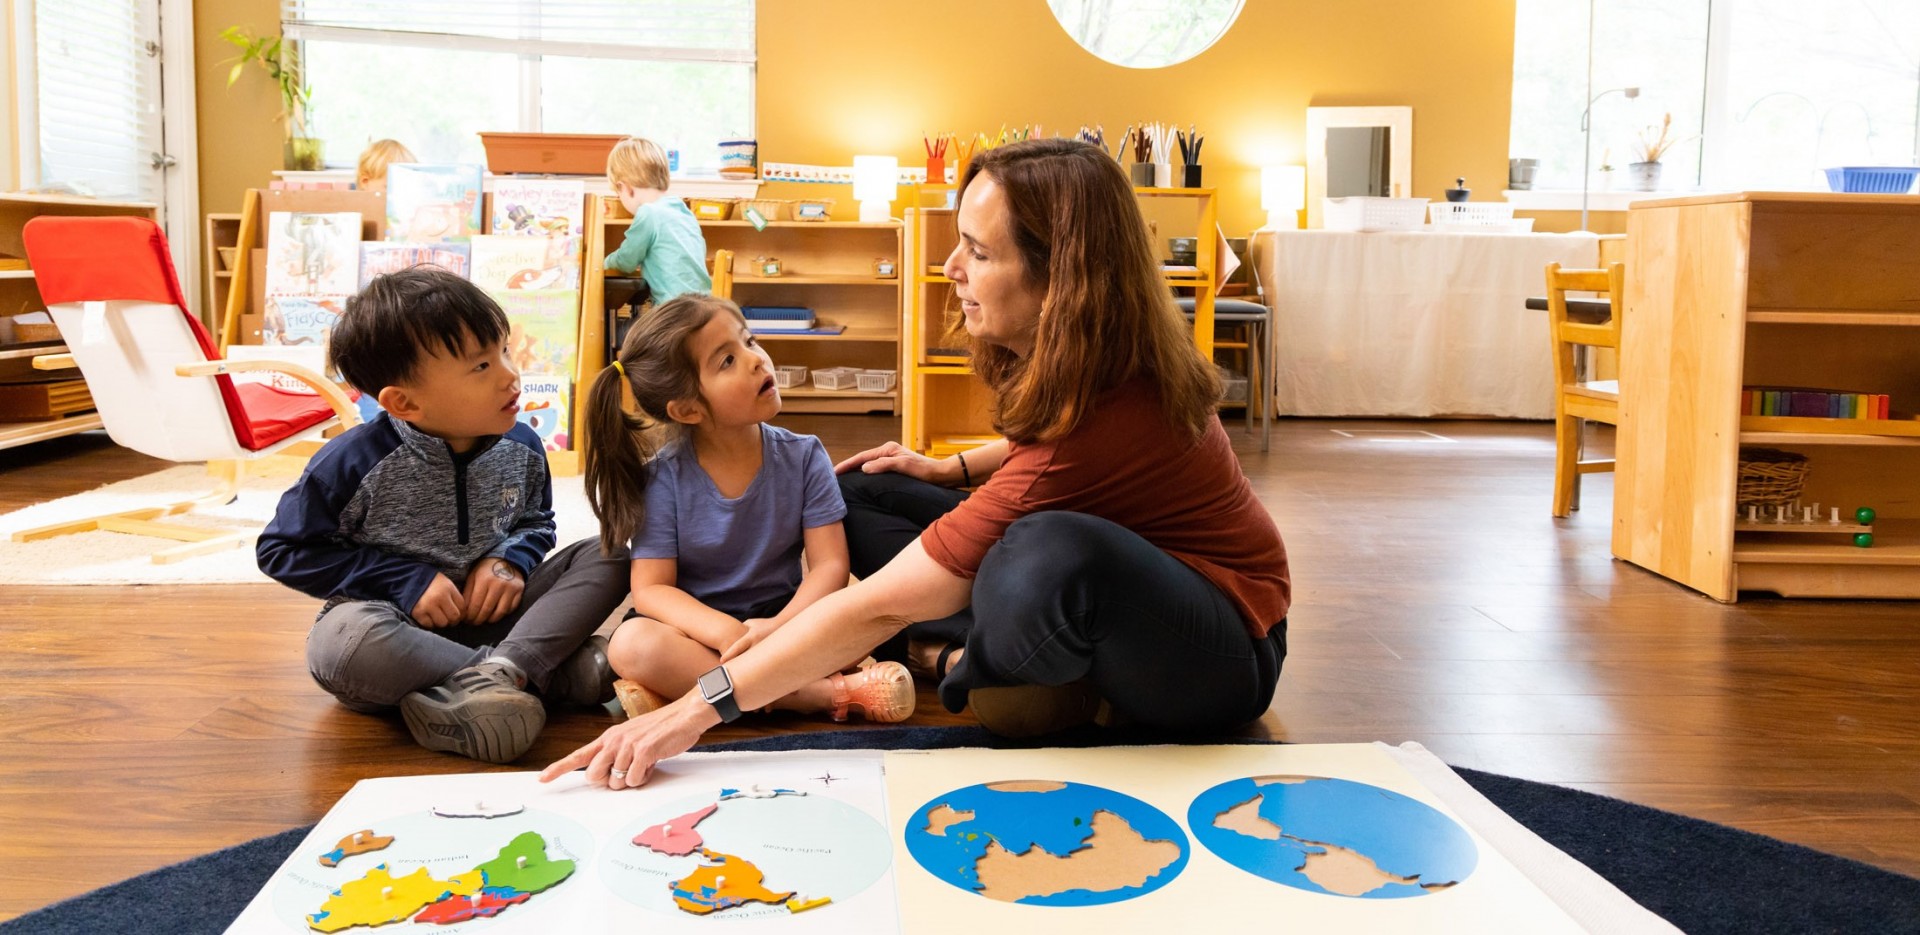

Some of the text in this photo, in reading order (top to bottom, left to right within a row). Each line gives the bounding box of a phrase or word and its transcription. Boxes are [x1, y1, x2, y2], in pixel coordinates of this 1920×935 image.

[498, 185, 543, 205] Marley
[285, 311, 336, 328] Fiasco
[271, 375, 307, 391] King
[524, 383, 558, 393] SHARK
[762, 843, 832, 854] Pacific Ocean
[398, 856, 431, 865] Ocean
[635, 866, 672, 878] Atlantic
[712, 907, 786, 920] Arctic Ocean
